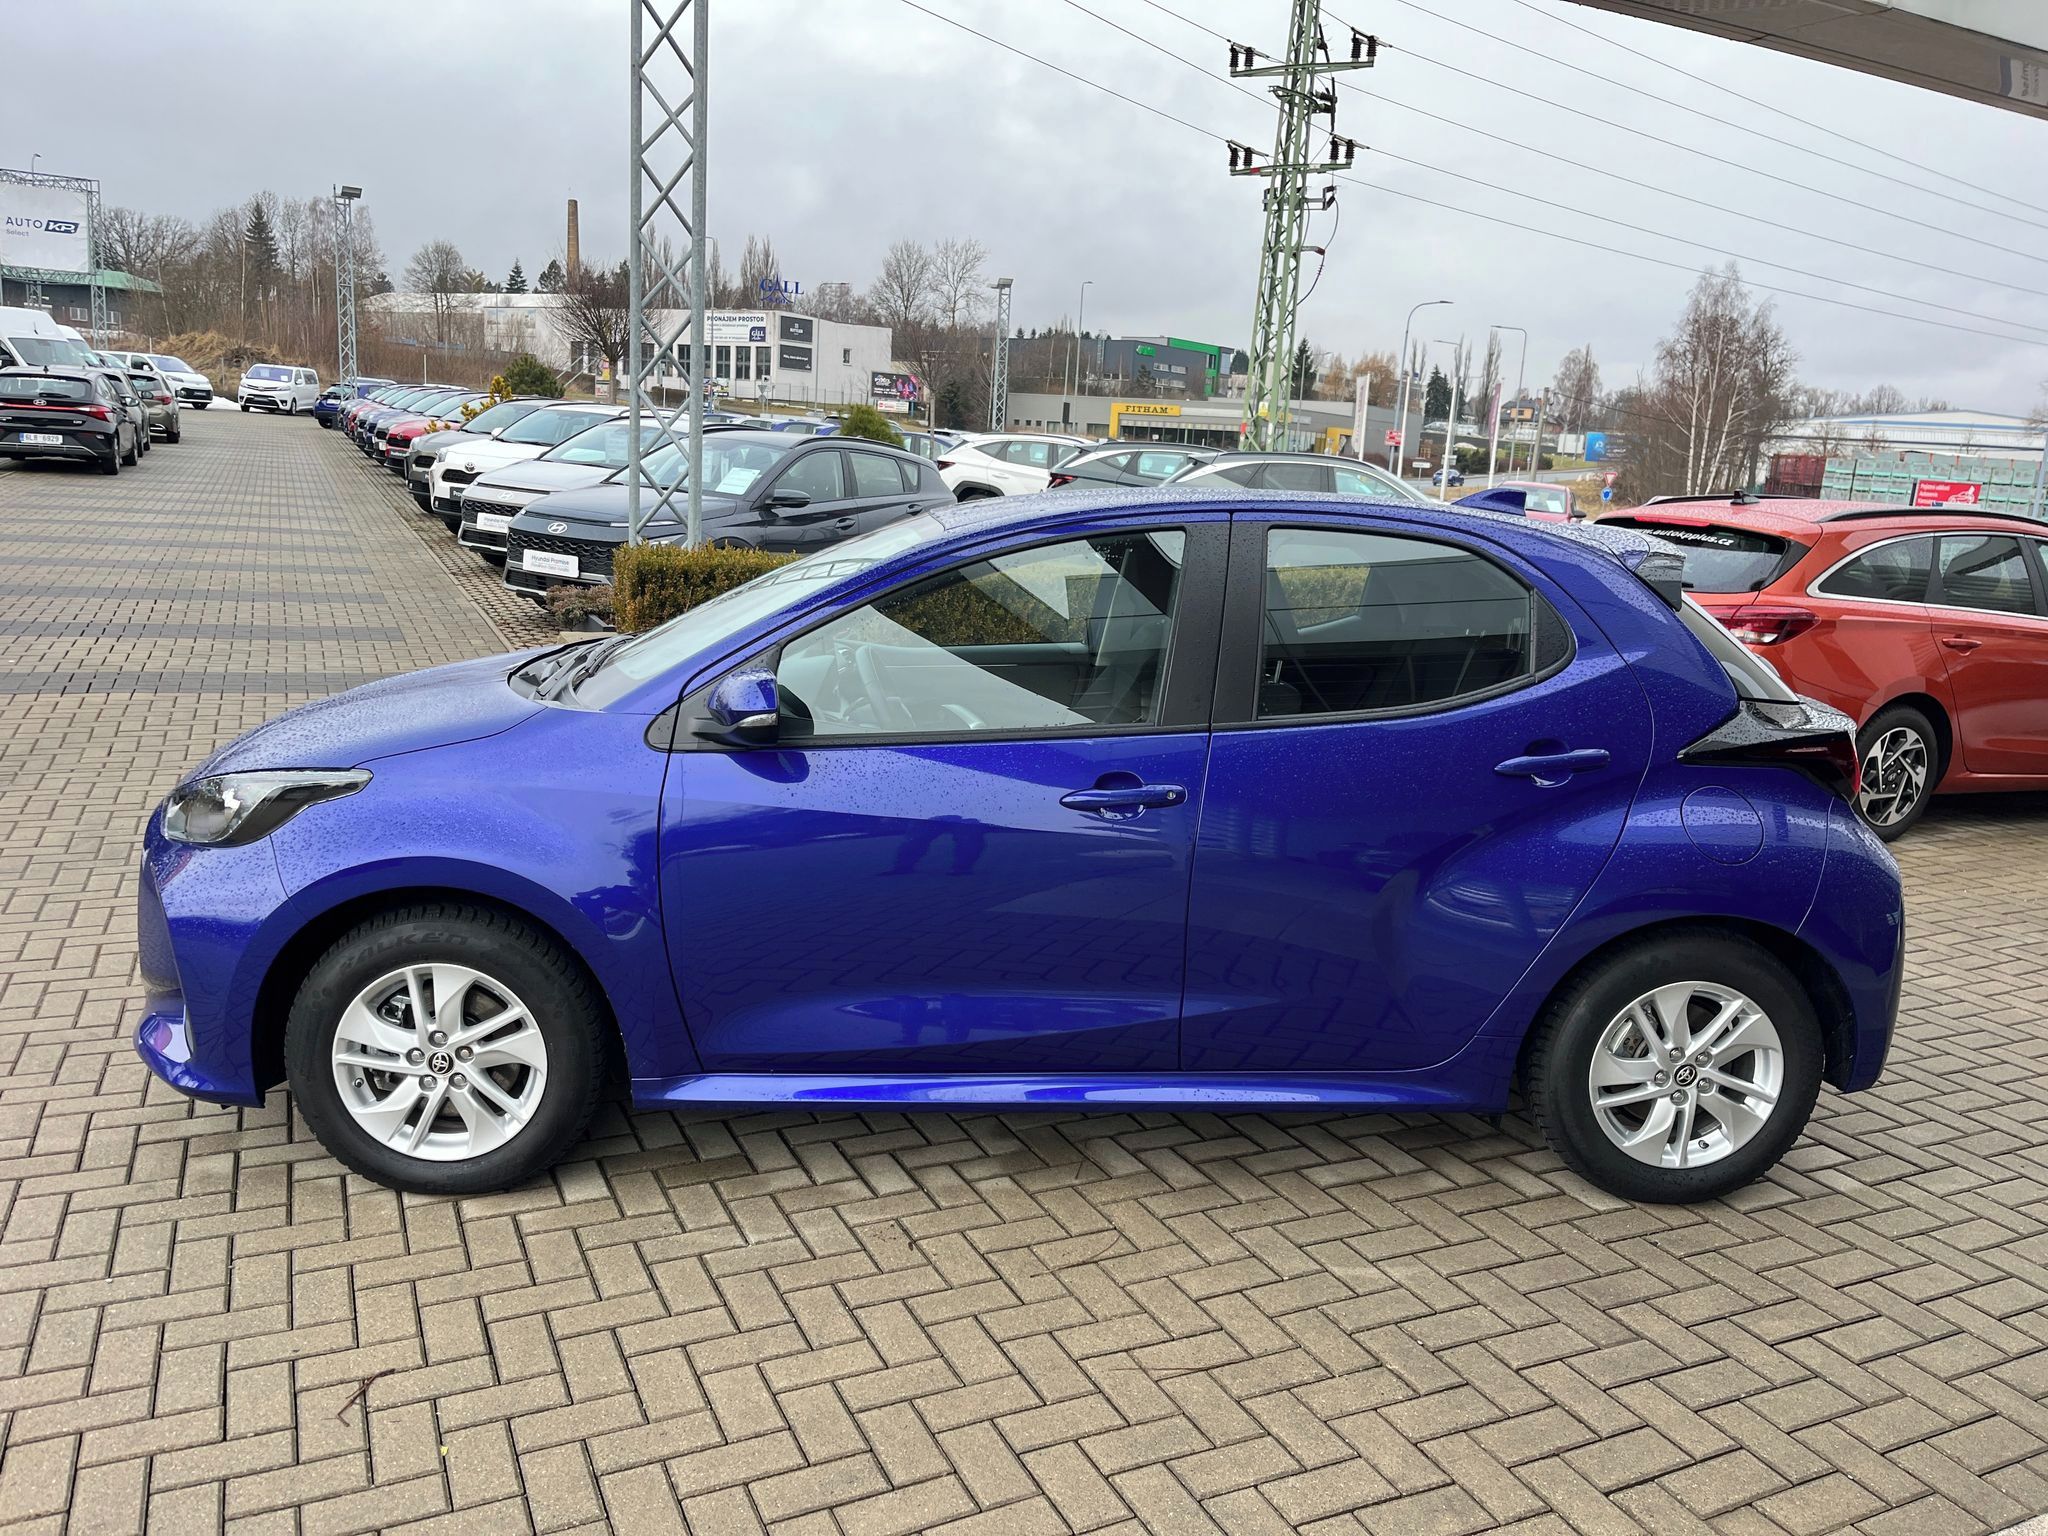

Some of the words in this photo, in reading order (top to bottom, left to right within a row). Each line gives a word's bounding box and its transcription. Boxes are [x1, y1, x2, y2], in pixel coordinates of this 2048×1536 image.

[5, 216, 43, 229] AUTO
[6, 229, 30, 237] Select
[1125, 405, 1168, 414] FITHAM
[531, 555, 550, 563] Hyundai
[550, 557, 570, 566] Promise
